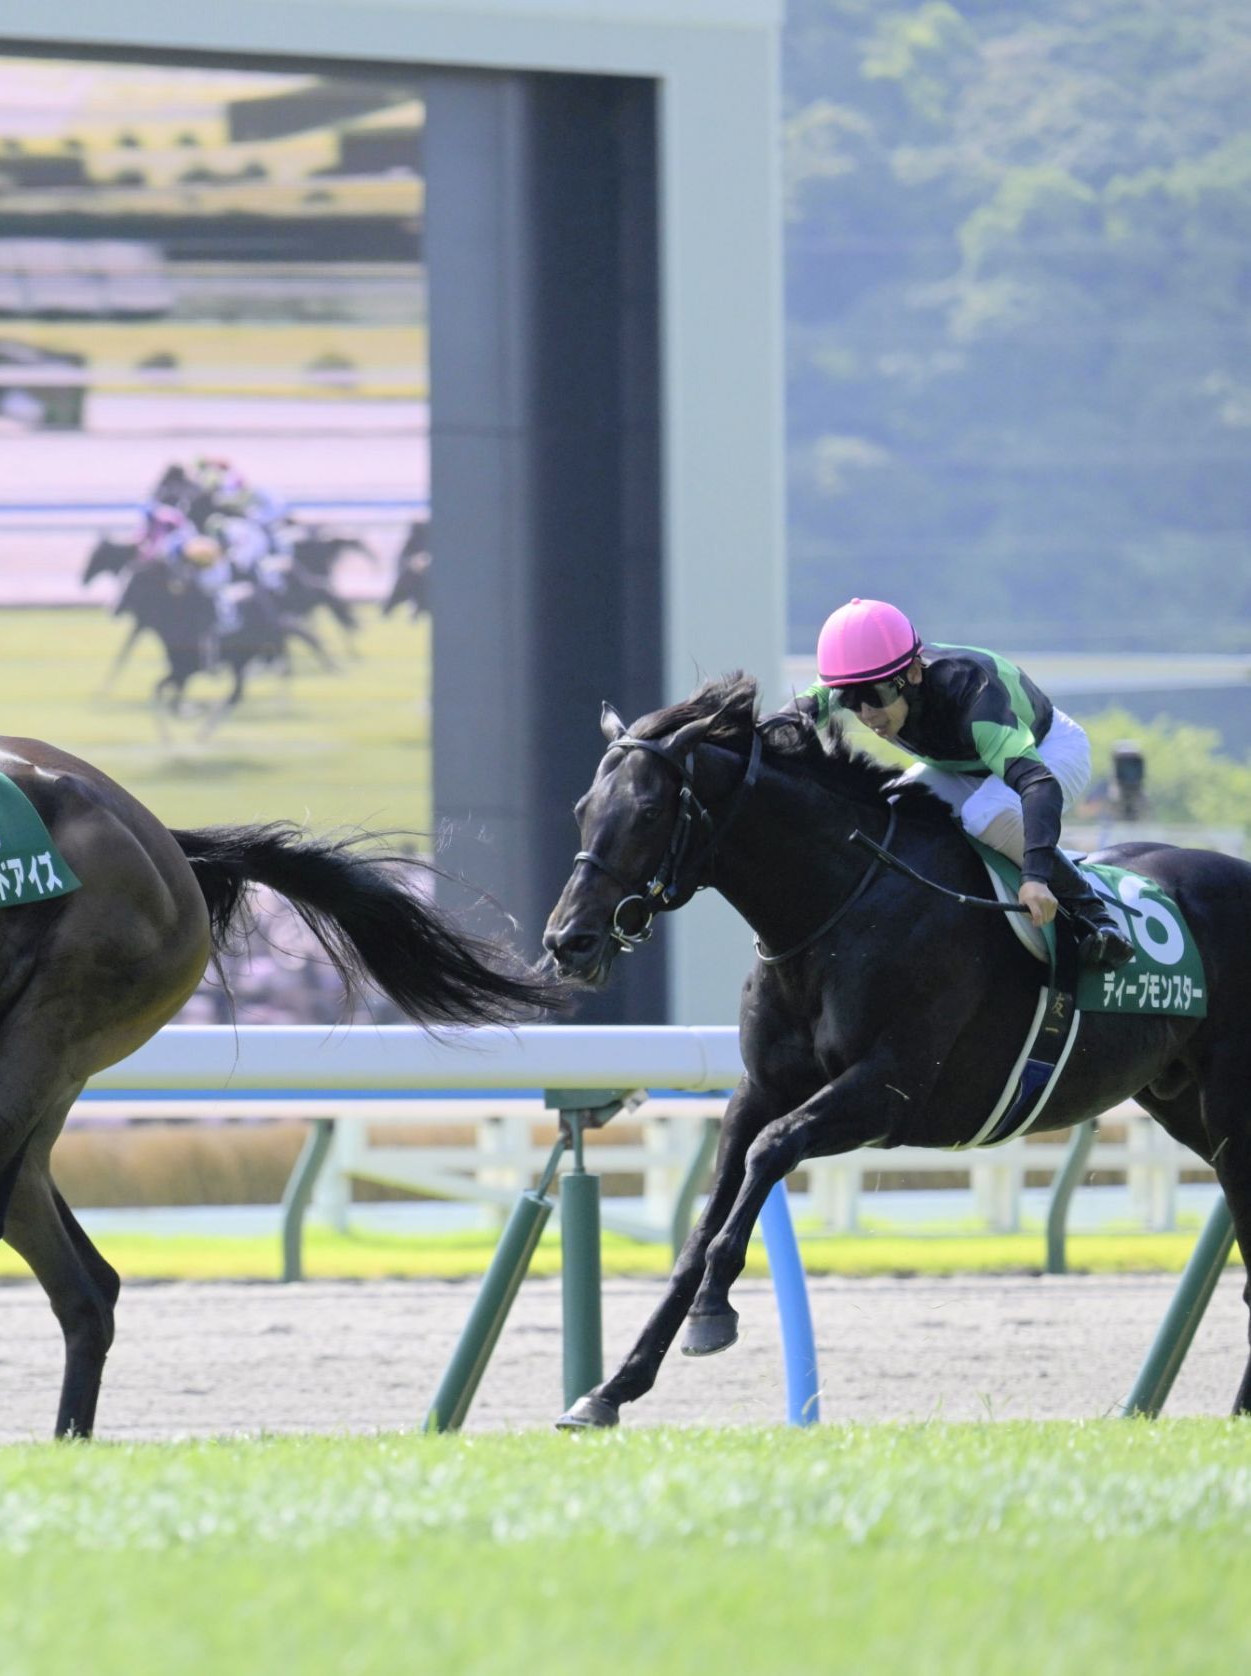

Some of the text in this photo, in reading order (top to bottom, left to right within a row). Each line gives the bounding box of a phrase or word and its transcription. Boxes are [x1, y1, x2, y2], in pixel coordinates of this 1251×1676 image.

[1103, 971, 1203, 1010] ディープモンスター
